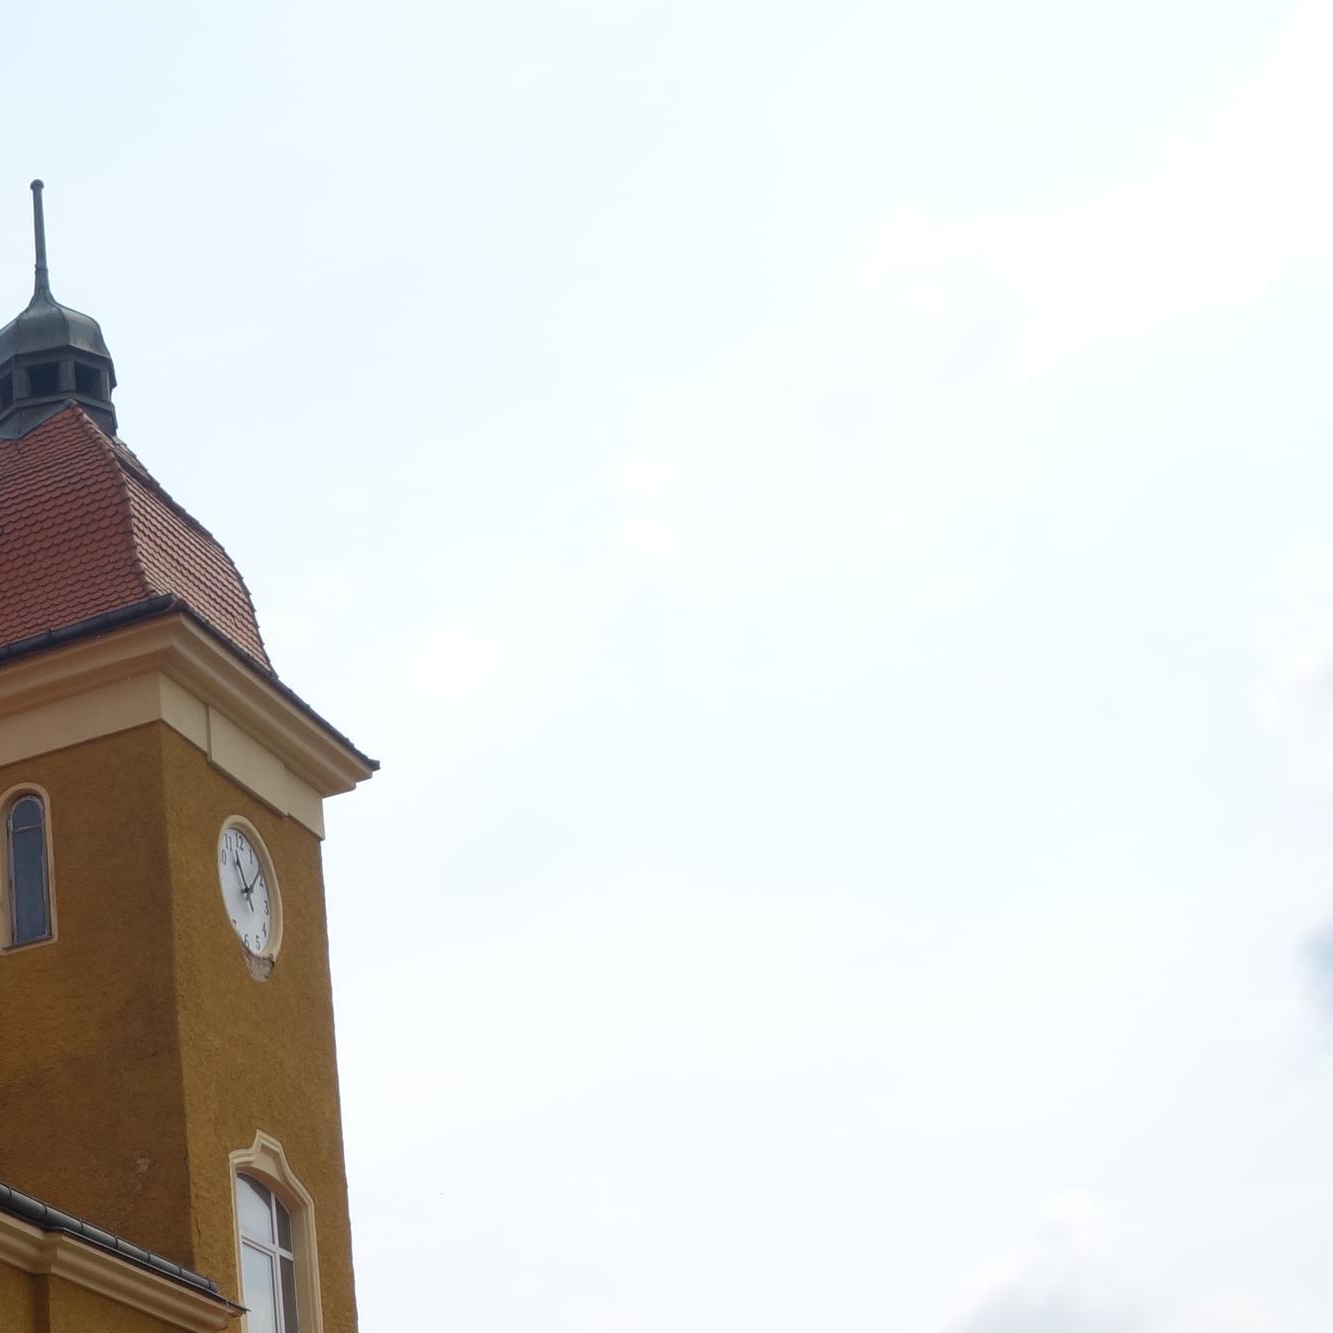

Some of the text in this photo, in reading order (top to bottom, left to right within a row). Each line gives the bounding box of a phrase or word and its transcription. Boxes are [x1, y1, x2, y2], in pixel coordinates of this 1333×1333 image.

[225, 833, 233, 851] 11
[235, 833, 244, 851] 12
[264, 900, 269, 916] 3
[262, 922, 267, 937] 4
[244, 934, 250, 949] 6
[255, 935, 260, 951] 5
